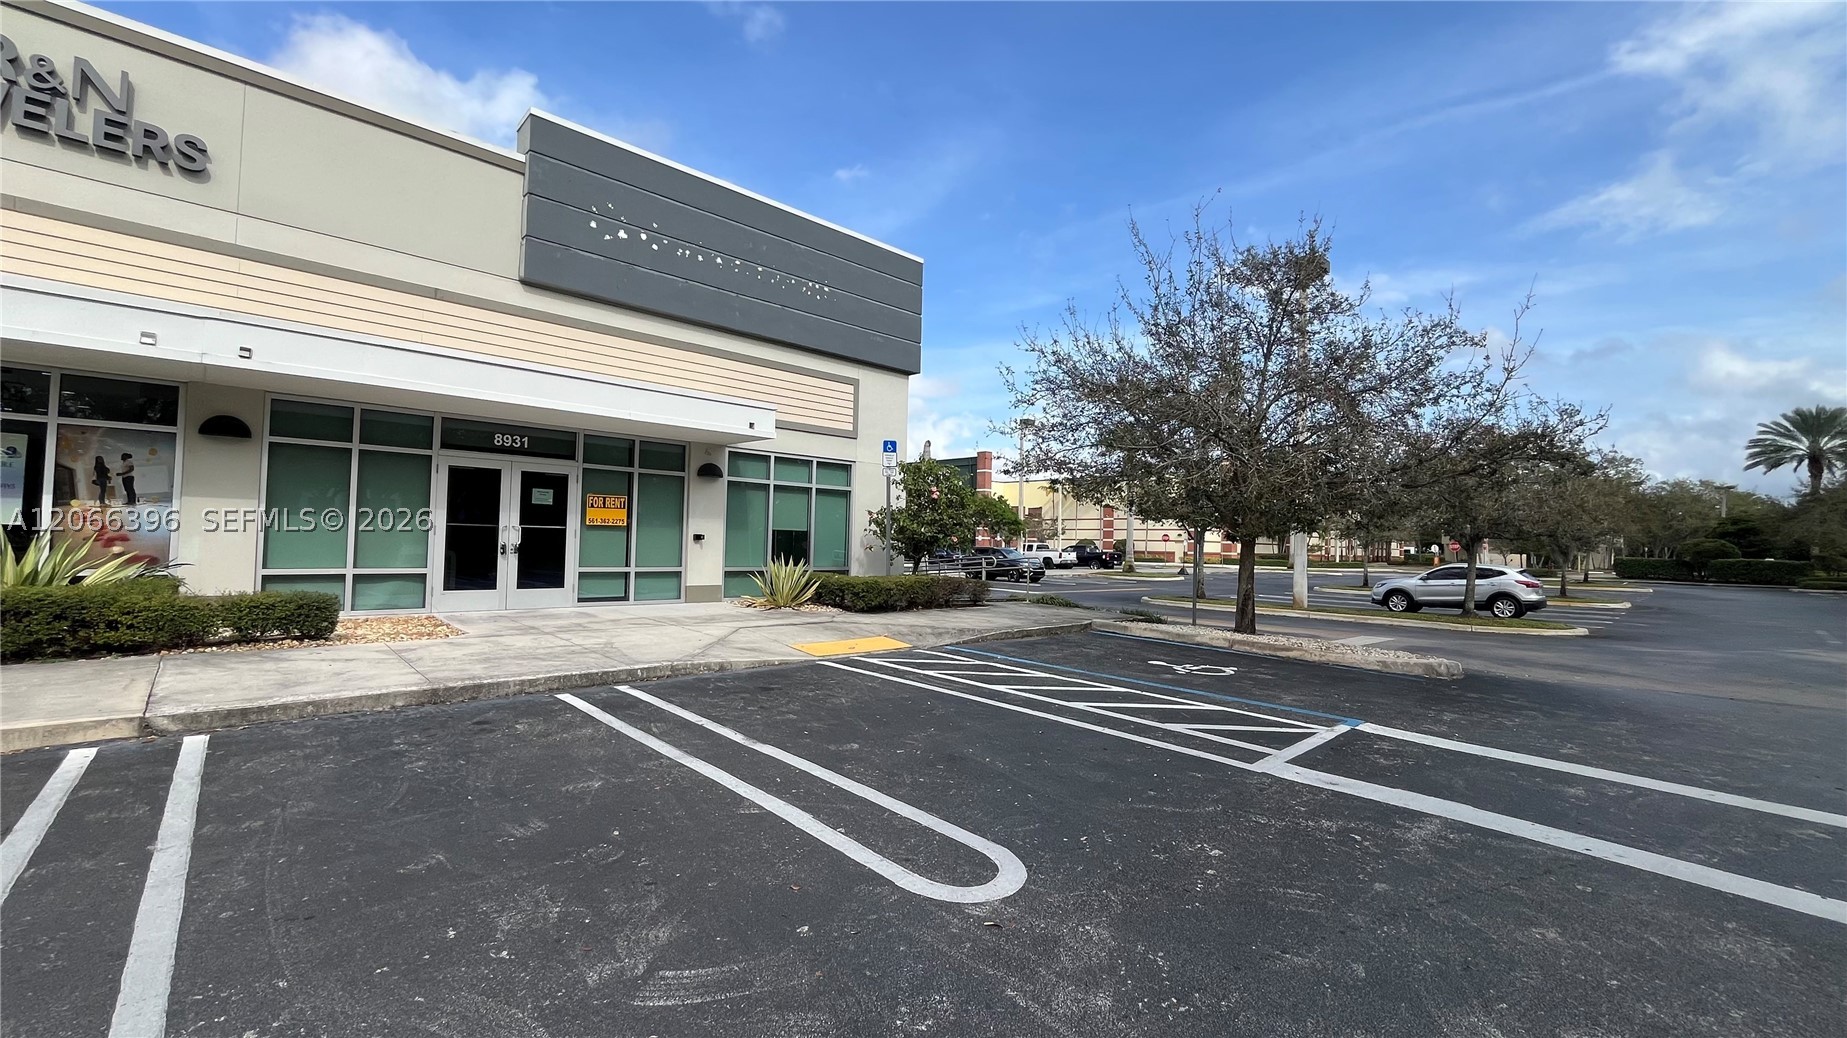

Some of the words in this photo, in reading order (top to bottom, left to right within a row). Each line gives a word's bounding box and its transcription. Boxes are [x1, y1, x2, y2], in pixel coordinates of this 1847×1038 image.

[494, 433, 528, 448] 8931
[588, 496, 604, 508] FOR
[605, 497, 625, 508] RENT
